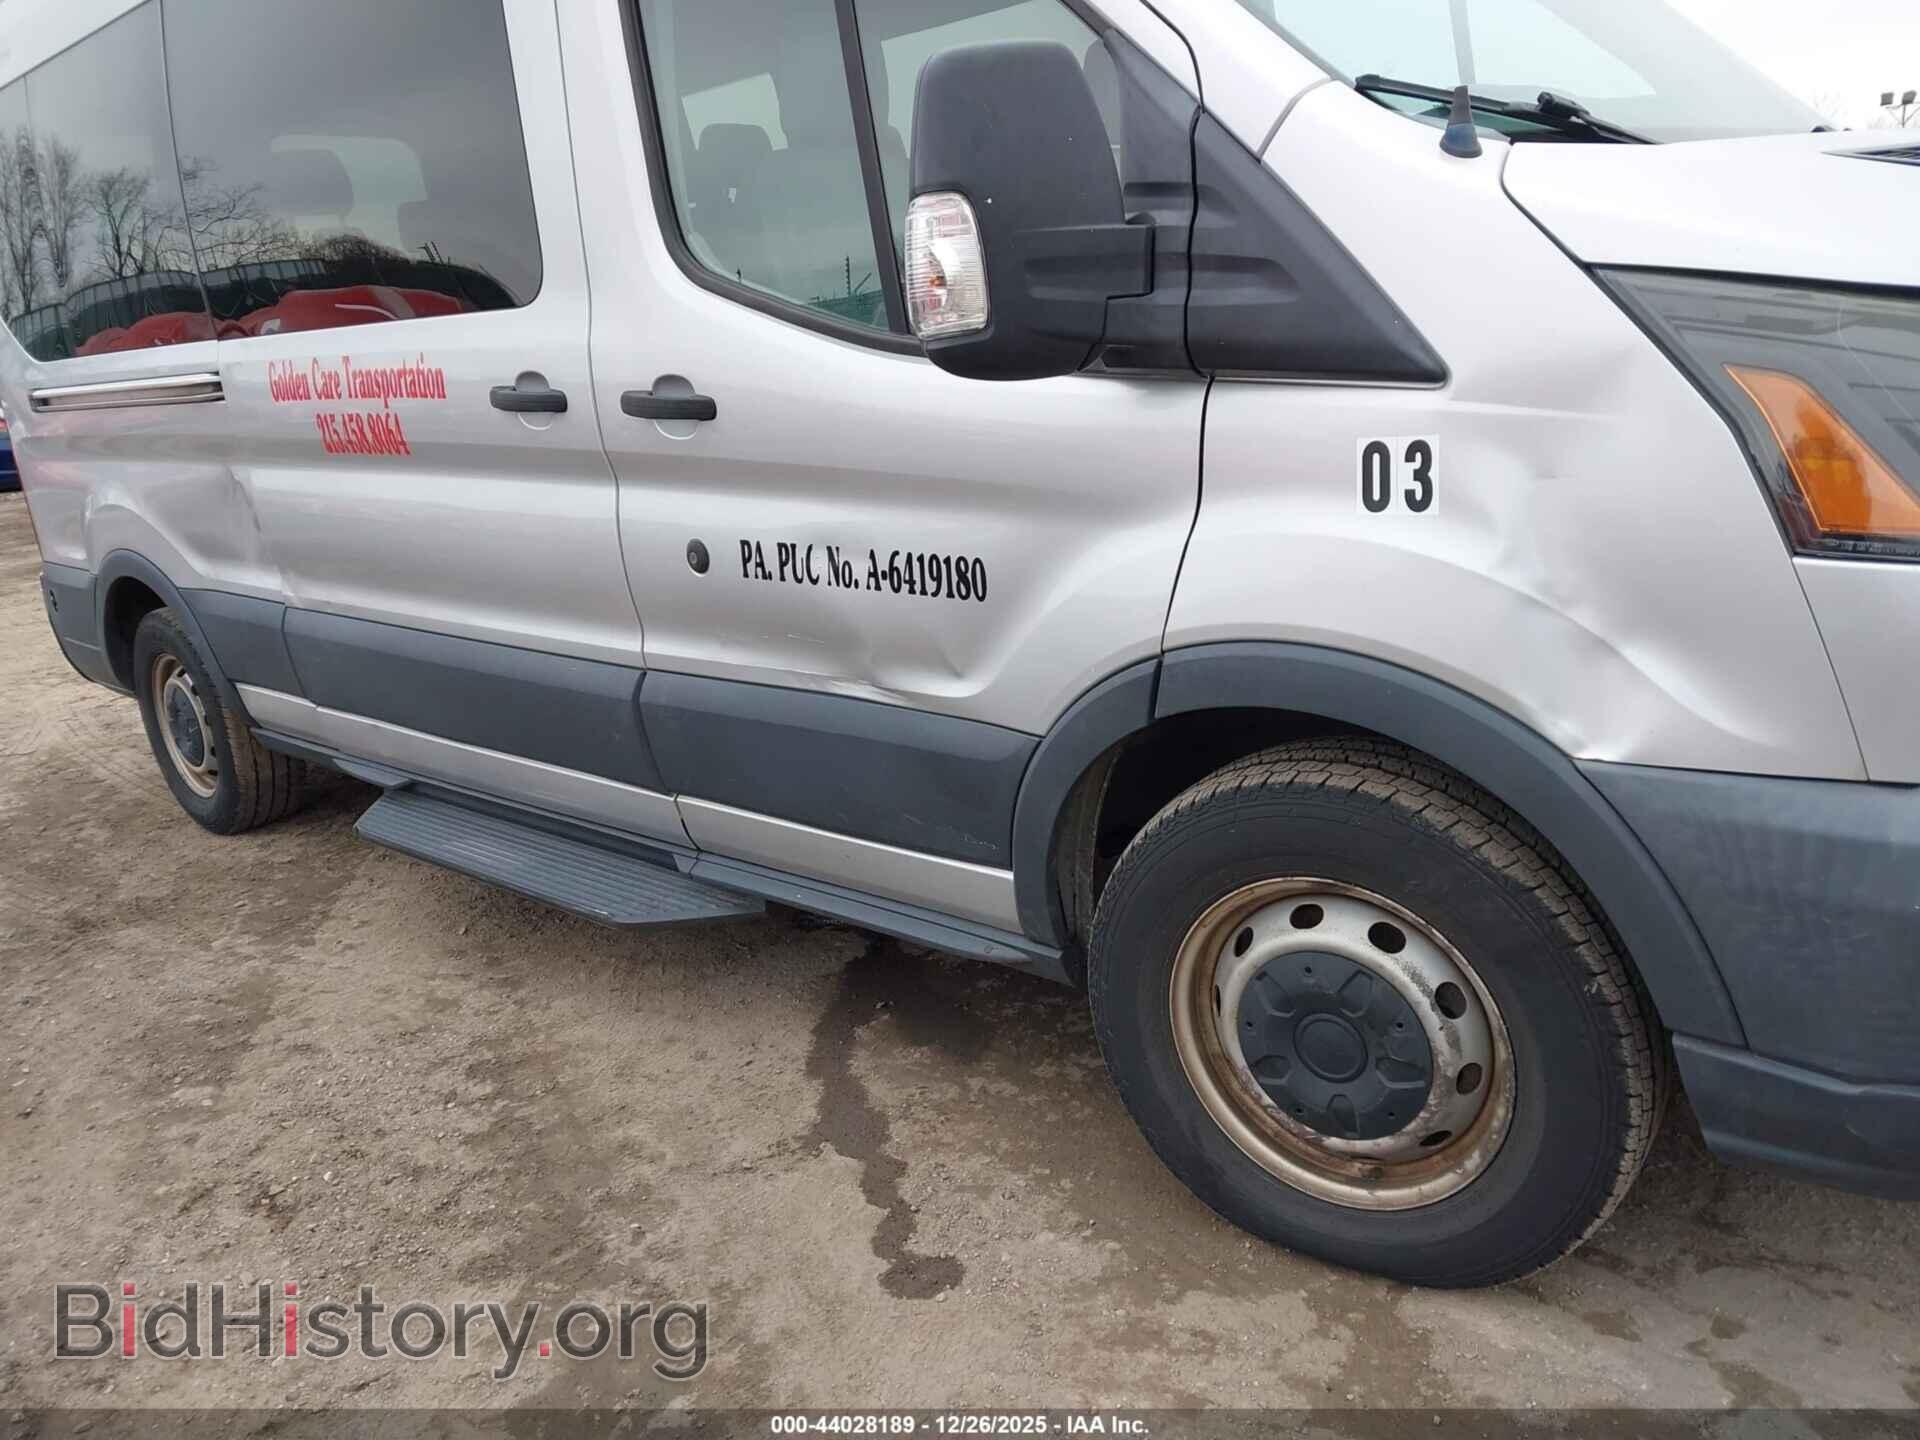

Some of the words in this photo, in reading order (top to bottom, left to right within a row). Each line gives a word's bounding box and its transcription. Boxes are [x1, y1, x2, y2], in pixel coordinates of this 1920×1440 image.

[267, 360, 312, 402] Golden
[312, 357, 343, 400] Care
[342, 352, 447, 409] Transportation
[316, 412, 411, 455] 215.458.8064
[1362, 439, 1433, 513] 03
[739, 539, 773, 581] PA.
[776, 541, 820, 586] PUC
[826, 545, 860, 590] No.
[866, 548, 988, 602] A-6419180
